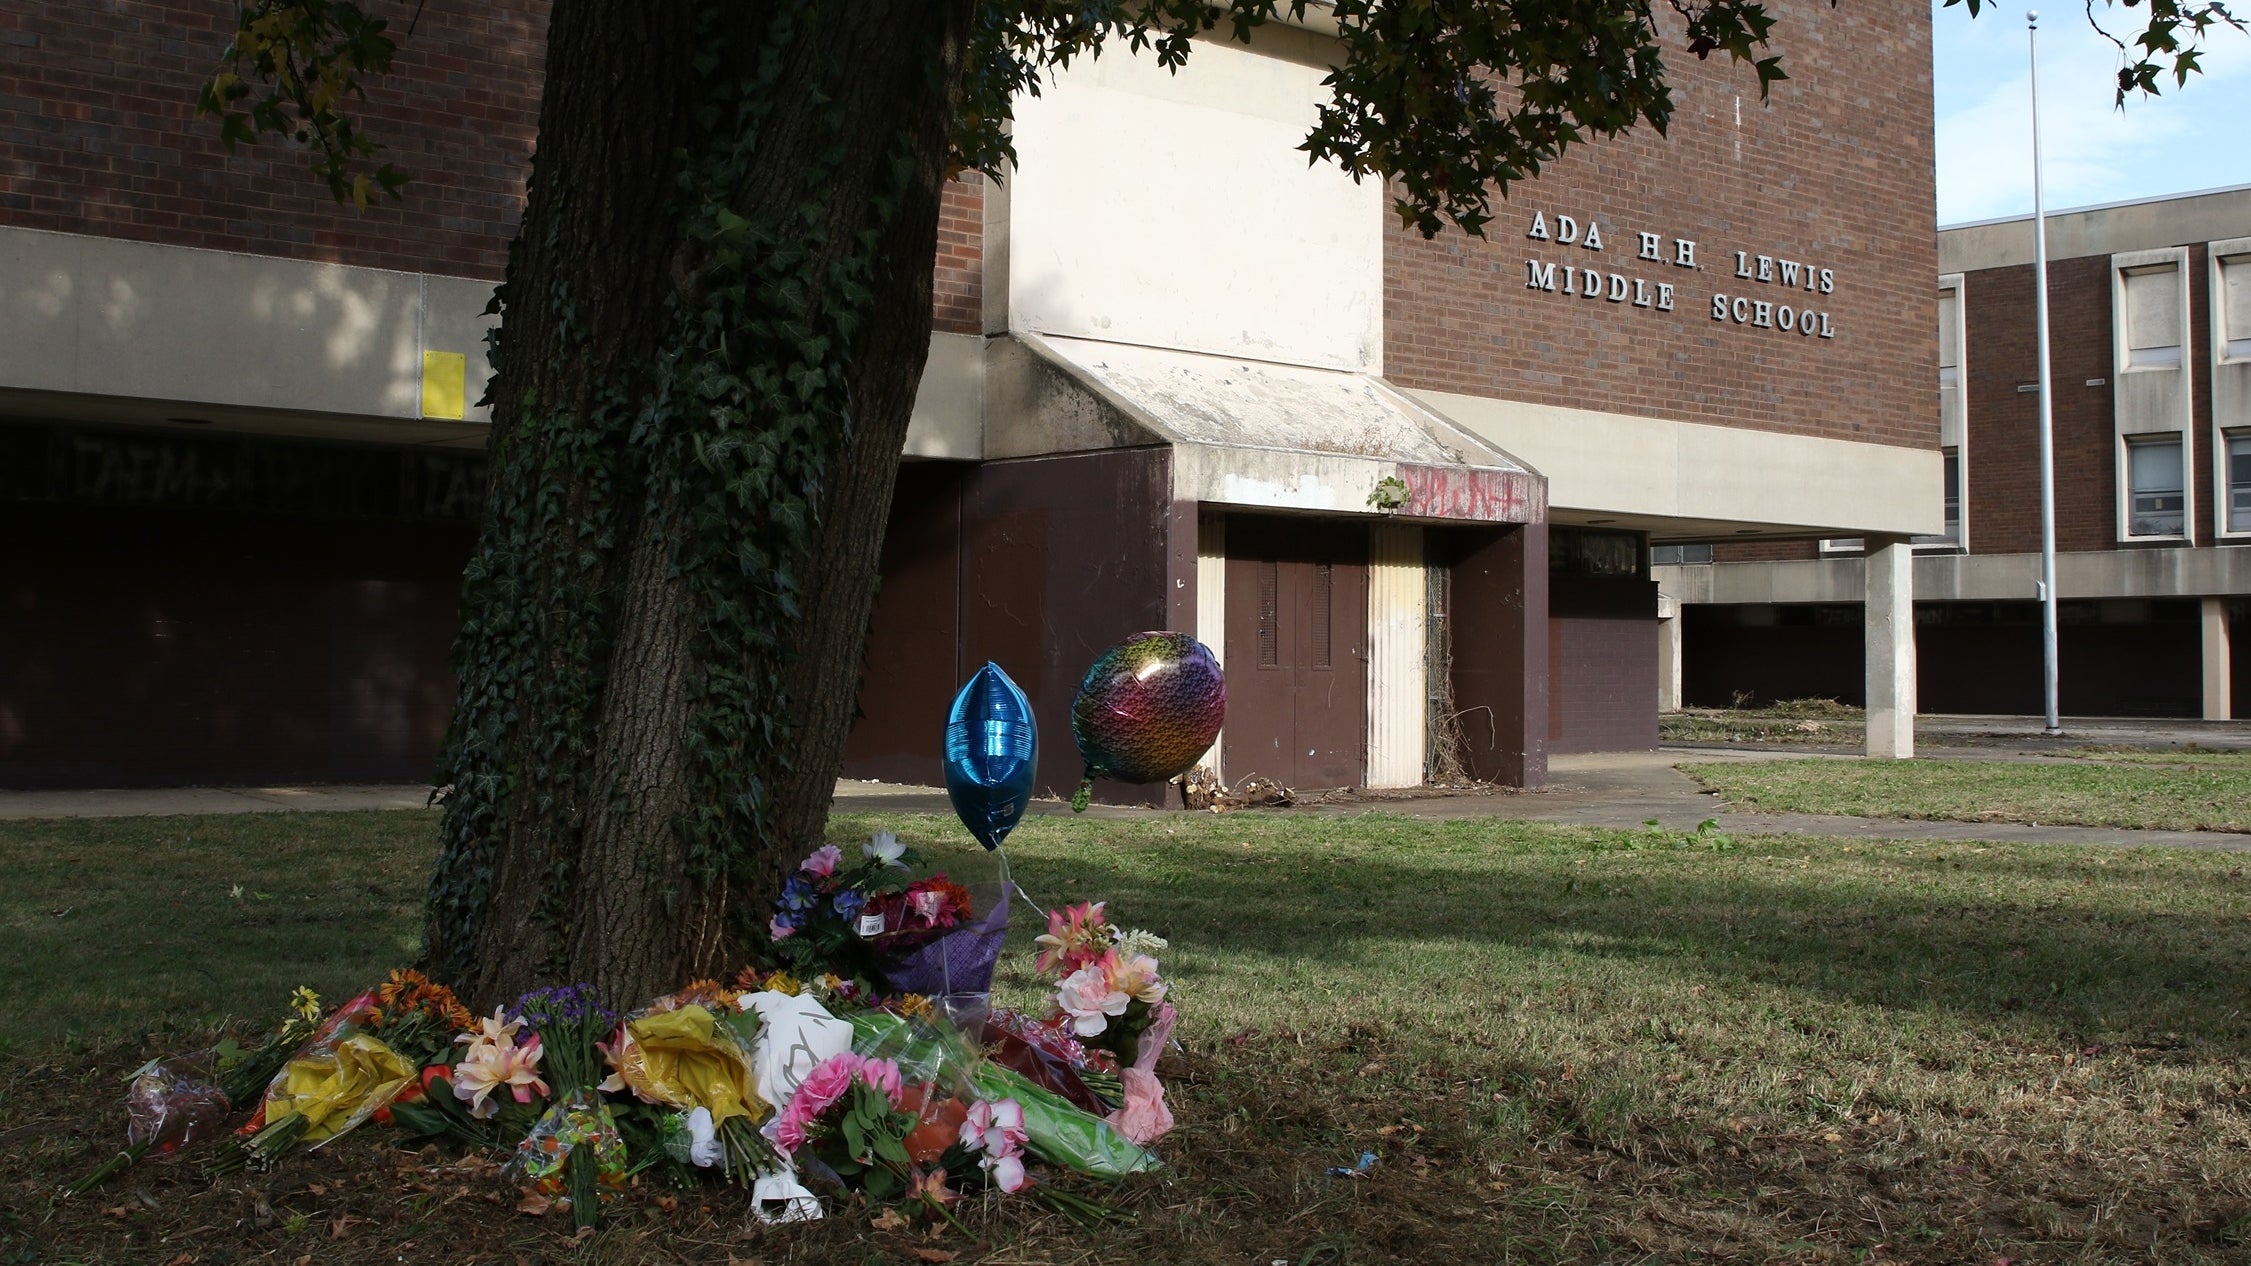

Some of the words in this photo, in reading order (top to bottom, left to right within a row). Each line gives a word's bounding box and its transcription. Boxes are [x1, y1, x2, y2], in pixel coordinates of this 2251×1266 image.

[1528, 210, 1604, 250] ADA
[1735, 250, 1835, 294] LEWIS
[1525, 258, 1675, 311] MIDDLE
[1711, 292, 1835, 338] SCHOOL
